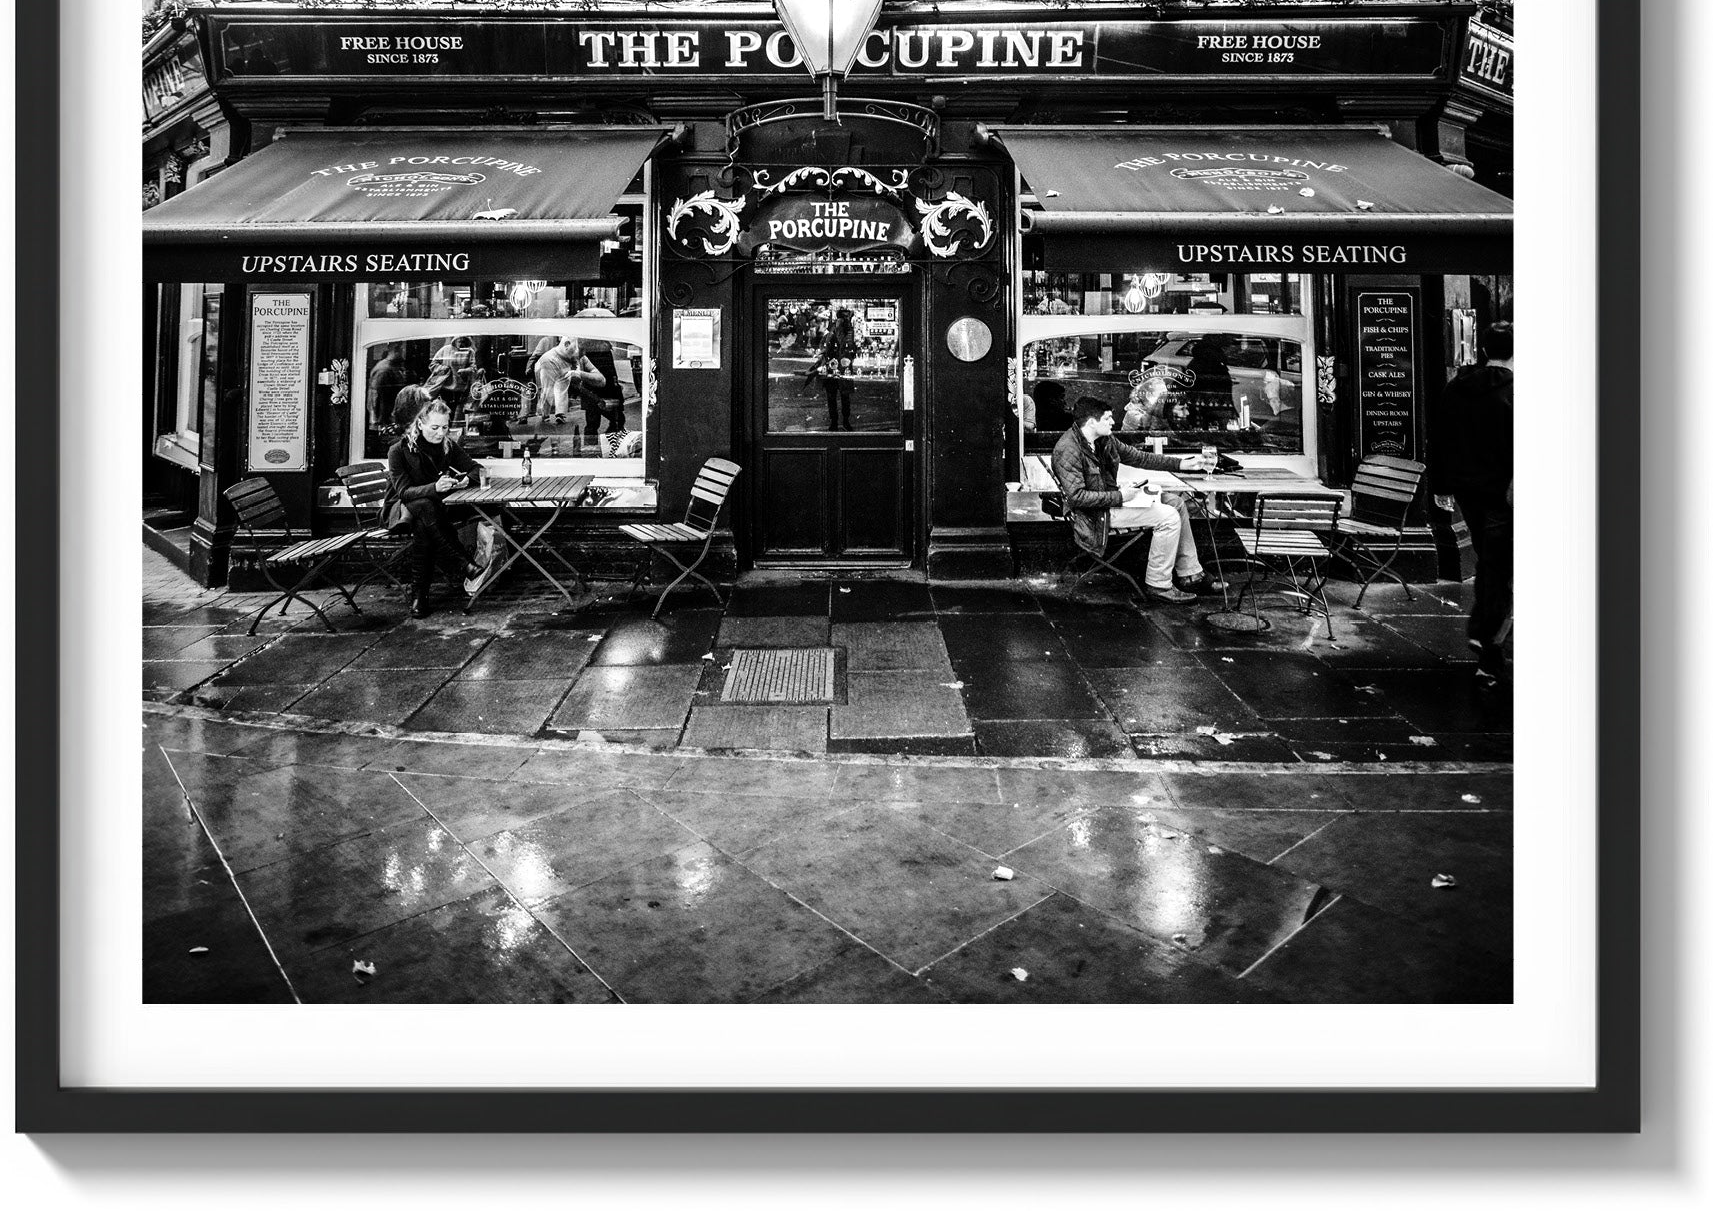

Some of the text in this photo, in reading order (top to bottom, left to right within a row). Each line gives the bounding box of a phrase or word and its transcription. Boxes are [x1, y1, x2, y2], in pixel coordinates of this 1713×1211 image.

[340, 36, 464, 50] FREE HOUSE
[579, 30, 1084, 68] THE POCUPINE
[1197, 35, 1321, 49] FREE HOUSE
[367, 53, 439, 64] SINCE 1873
[1221, 52, 1294, 63] SINCE 1873
[1467, 35, 1510, 85] THE
[310, 156, 542, 178] THE PORCUPINE
[1114, 152, 1349, 173] THE PORCUPINE
[810, 201, 850, 217] THE
[768, 218, 891, 242] PORCUPINE
[1177, 244, 1407, 263] UPSTAIRS SEATING
[241, 252, 470, 273] UPSTAIRS SEATING
[272, 299, 291, 307] THE
[1377, 298, 1394, 306] THE
[254, 306, 309, 316] PORCUPINE
